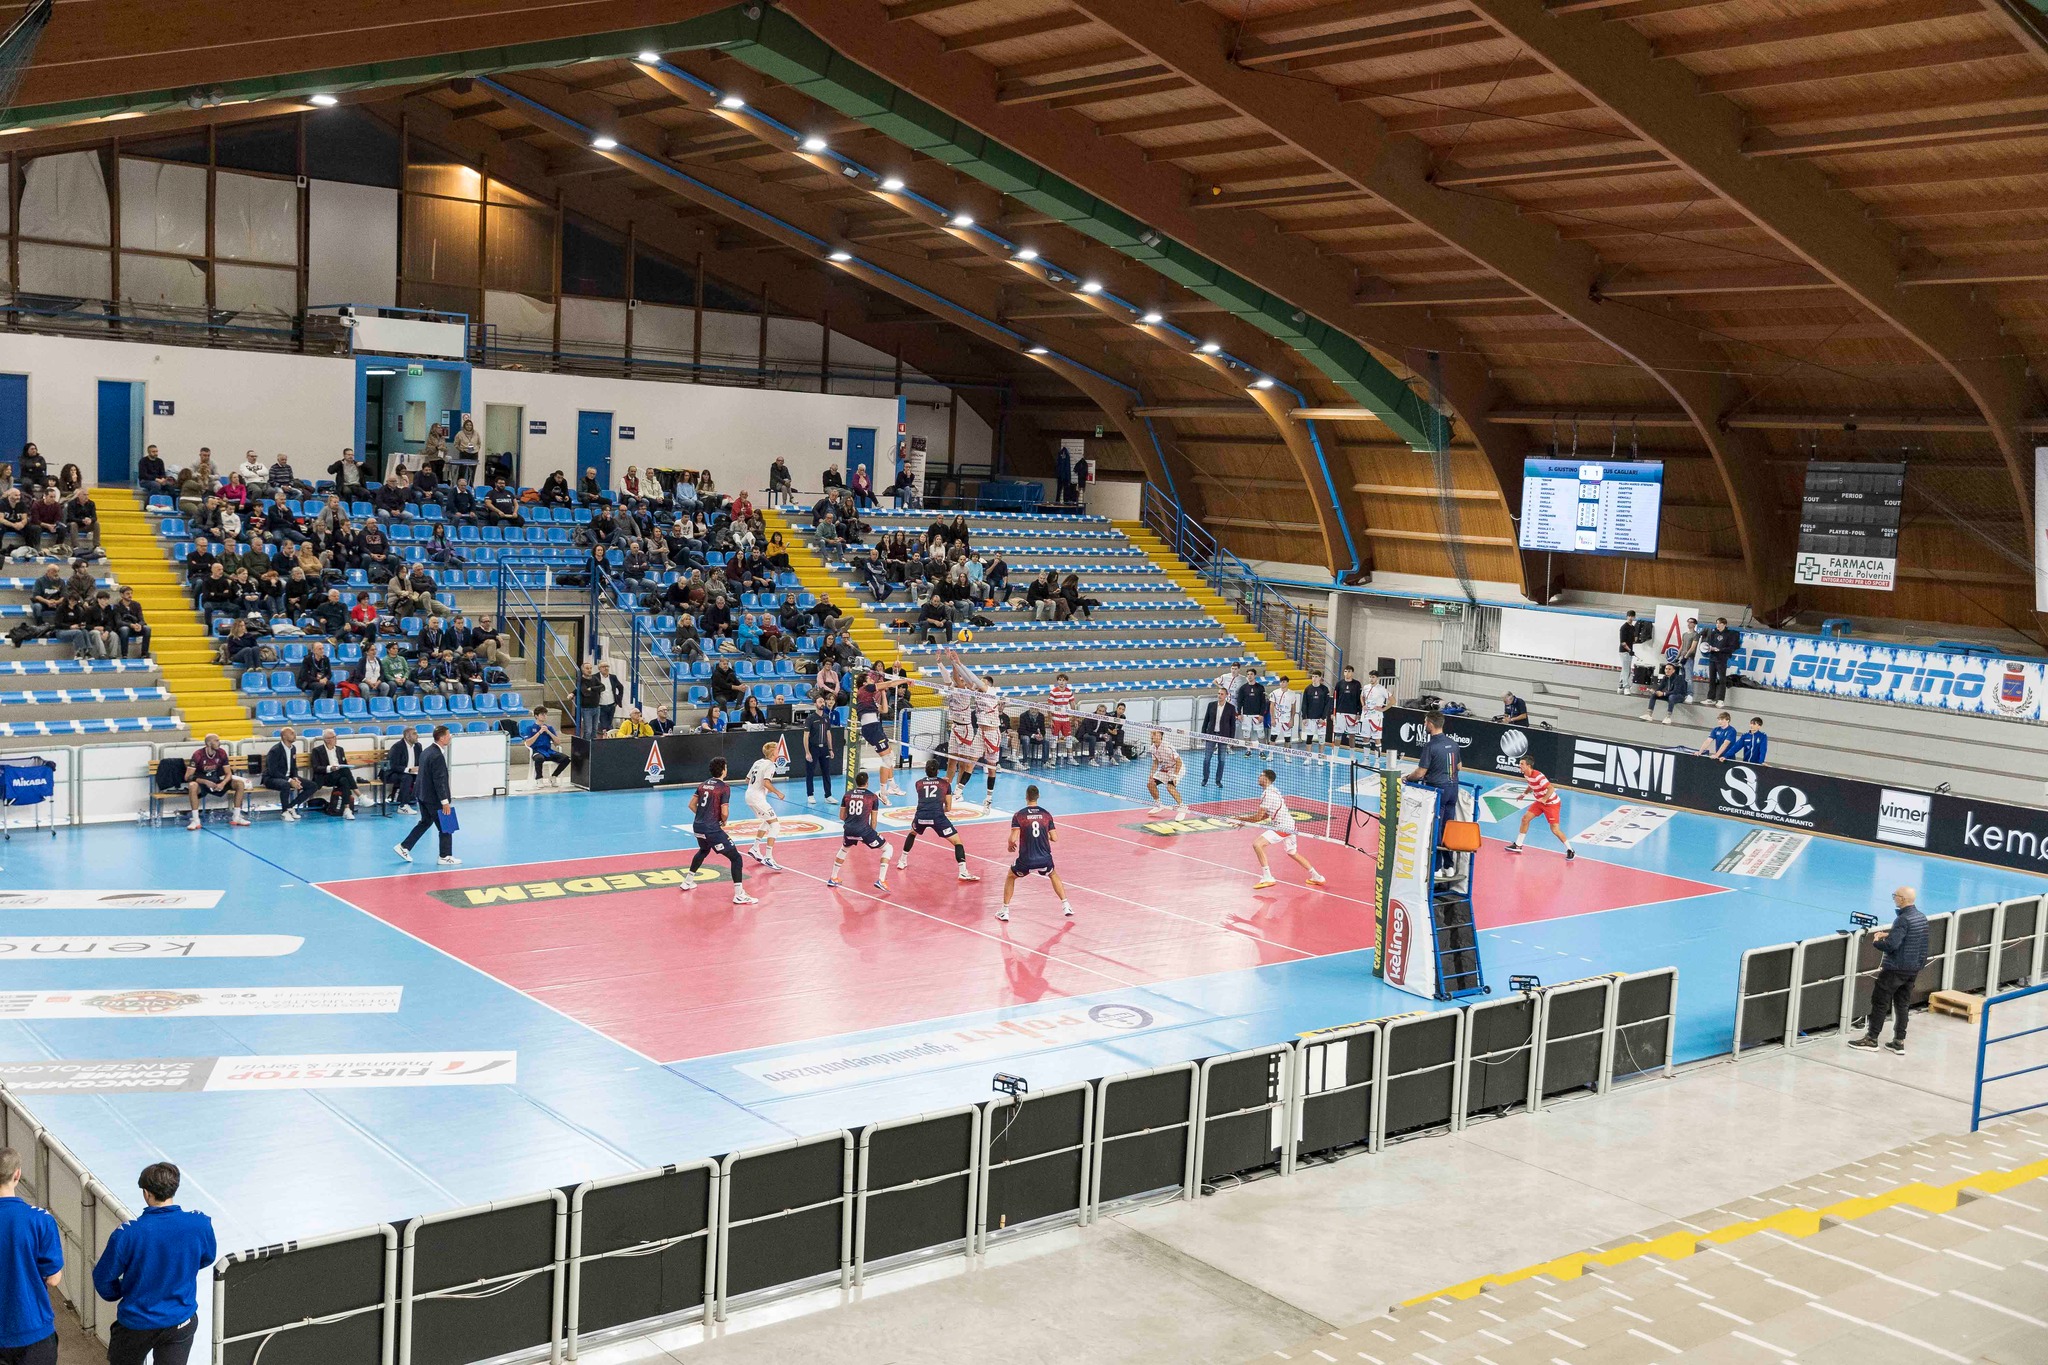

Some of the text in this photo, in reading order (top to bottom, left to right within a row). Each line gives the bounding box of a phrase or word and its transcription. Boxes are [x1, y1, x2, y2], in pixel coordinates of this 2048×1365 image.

[1829, 557, 1884, 571] FARMACIA
[1821, 568, 1892, 580] Eredi dr. Polverini
[1822, 576, 1854, 584] INTEGRATORI
[1125, 719, 1146, 728] PALLAVOLO
[1153, 724, 1172, 733] GIUSTINO
[1189, 731, 1211, 739] PALLAVOLO
[1219, 736, 1240, 745] GIUSTINO
[1258, 743, 1282, 752] PALLAVOLO
[1291, 749, 1313, 758] GIUSTINO
[847, 747, 856, 778] BANCA
[700, 791, 709, 807] 3
[923, 785, 938, 798] 12
[1379, 776, 1387, 821] BANCA
[848, 799, 864, 816] 88
[1881, 801, 1930, 823] vimer
[1718, 805, 1814, 828] COPERTURE BONIFICA AMIANTO
[1031, 820, 1040, 838] 8
[1376, 825, 1386, 871] CREDEM
[463, 867, 721, 905] CREDEM
[1375, 877, 1383, 920] BANCA
[1373, 923, 1382, 970] CREDEM
[232, 1063, 299, 1071] Servizi
[325, 1060, 433, 1068] Pneumatici
[69, 1070, 190, 1080] GOMME
[227, 1067, 429, 1080] FIRSTSTOP
